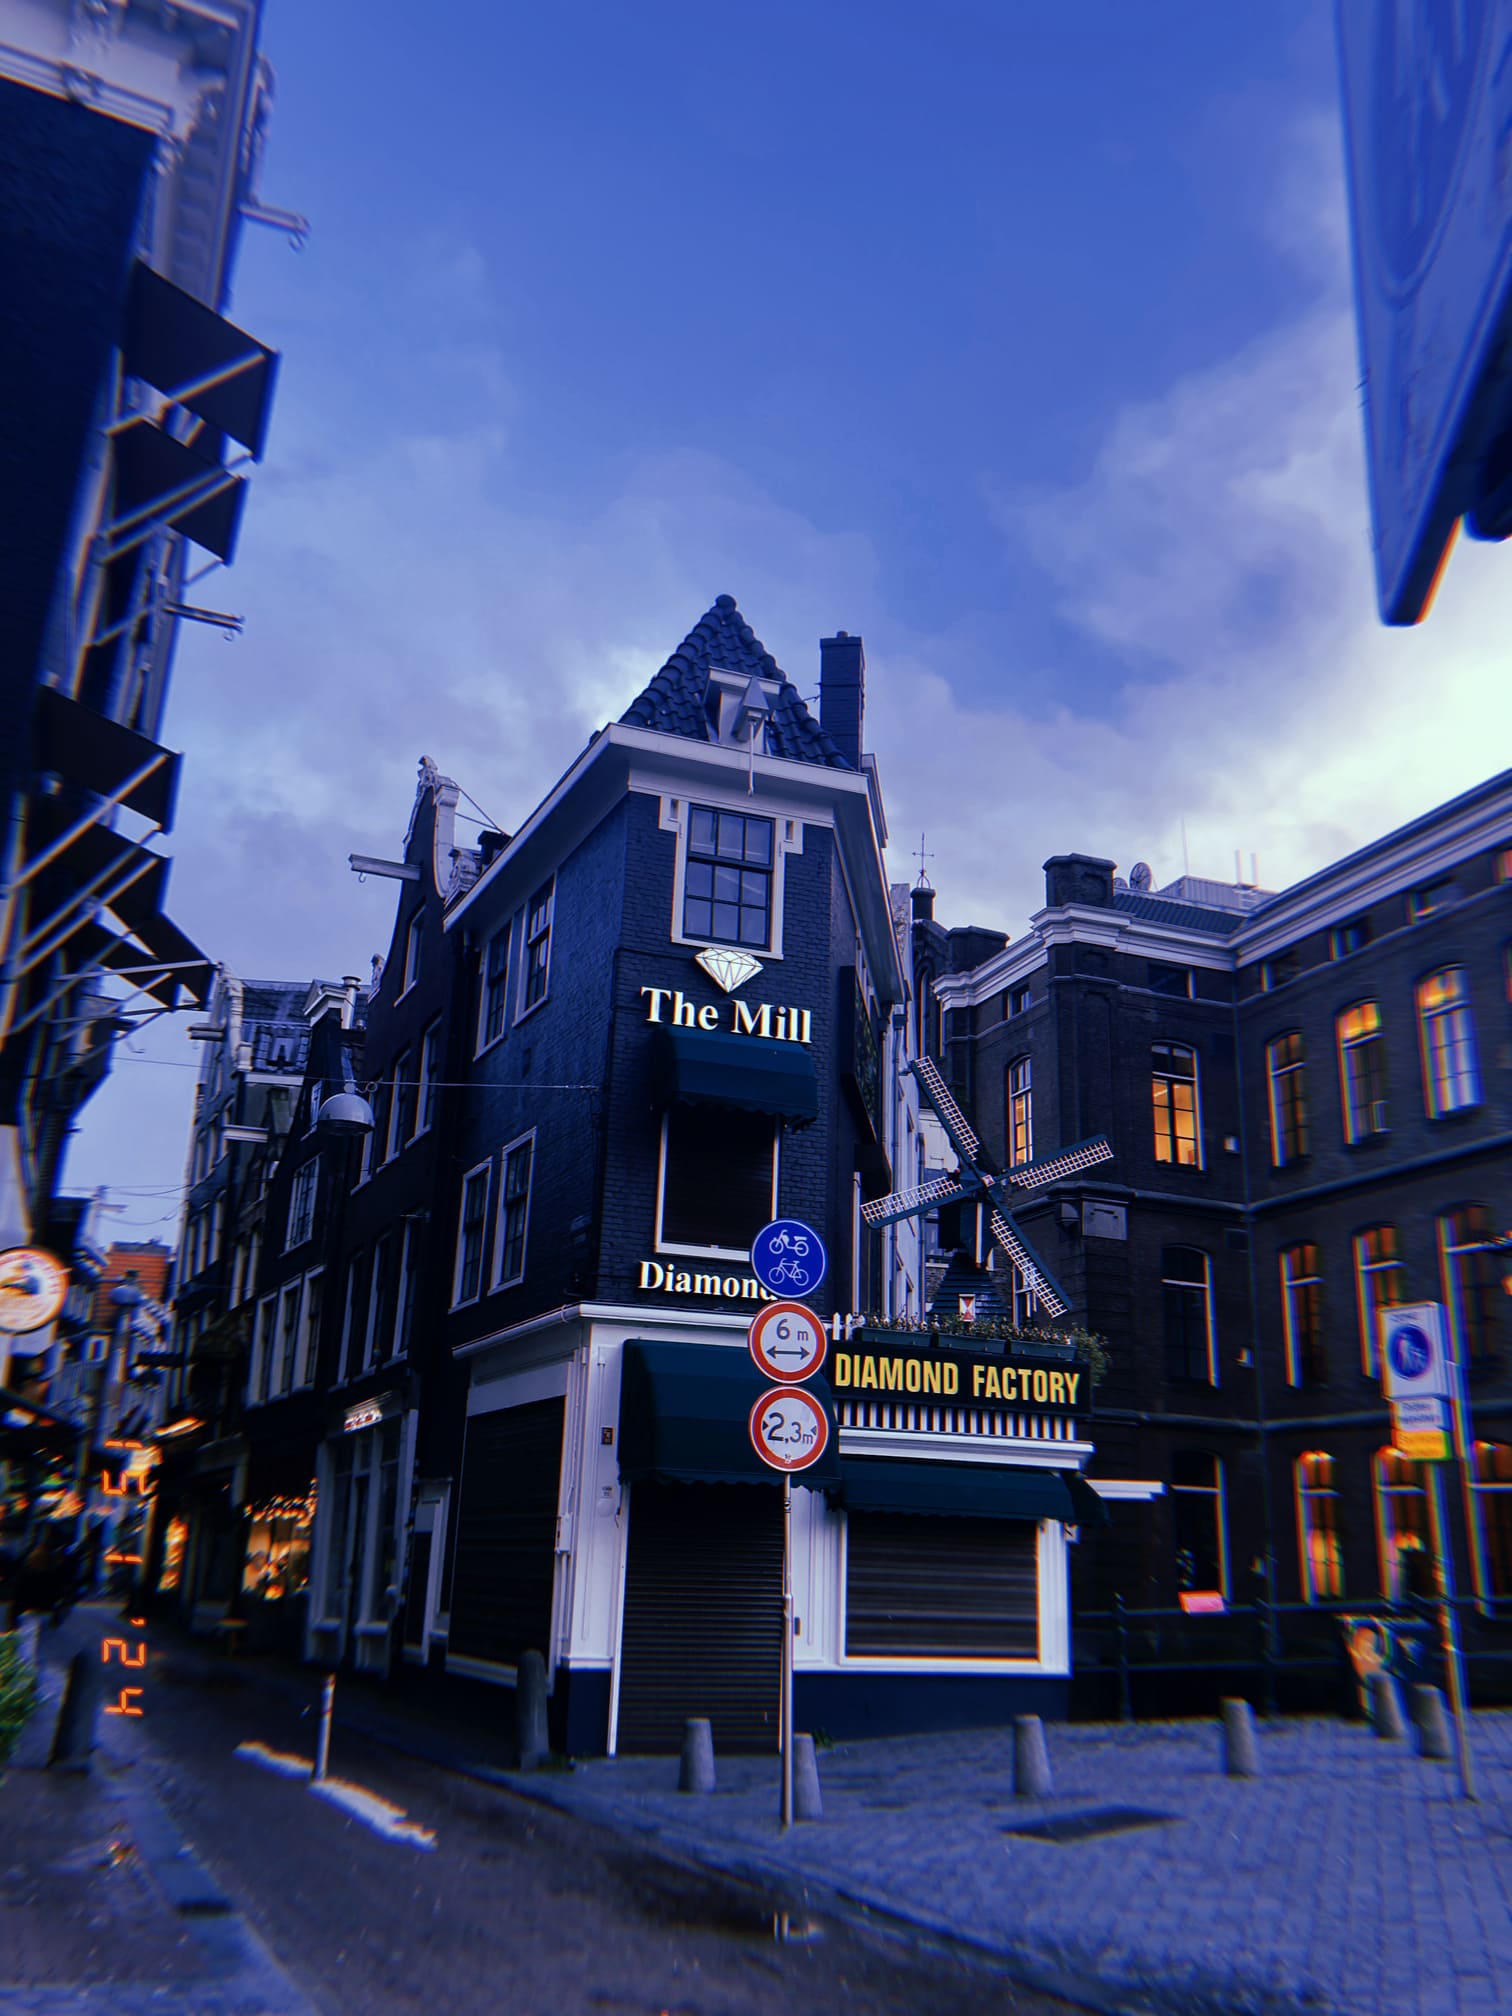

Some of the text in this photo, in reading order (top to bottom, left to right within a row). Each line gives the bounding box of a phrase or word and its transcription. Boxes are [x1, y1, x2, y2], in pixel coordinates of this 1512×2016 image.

[640, 986, 812, 1043] The Mill
[776, 1319, 809, 1341] 6 m
[835, 1353, 1080, 1404] DIAMOND FACTORY
